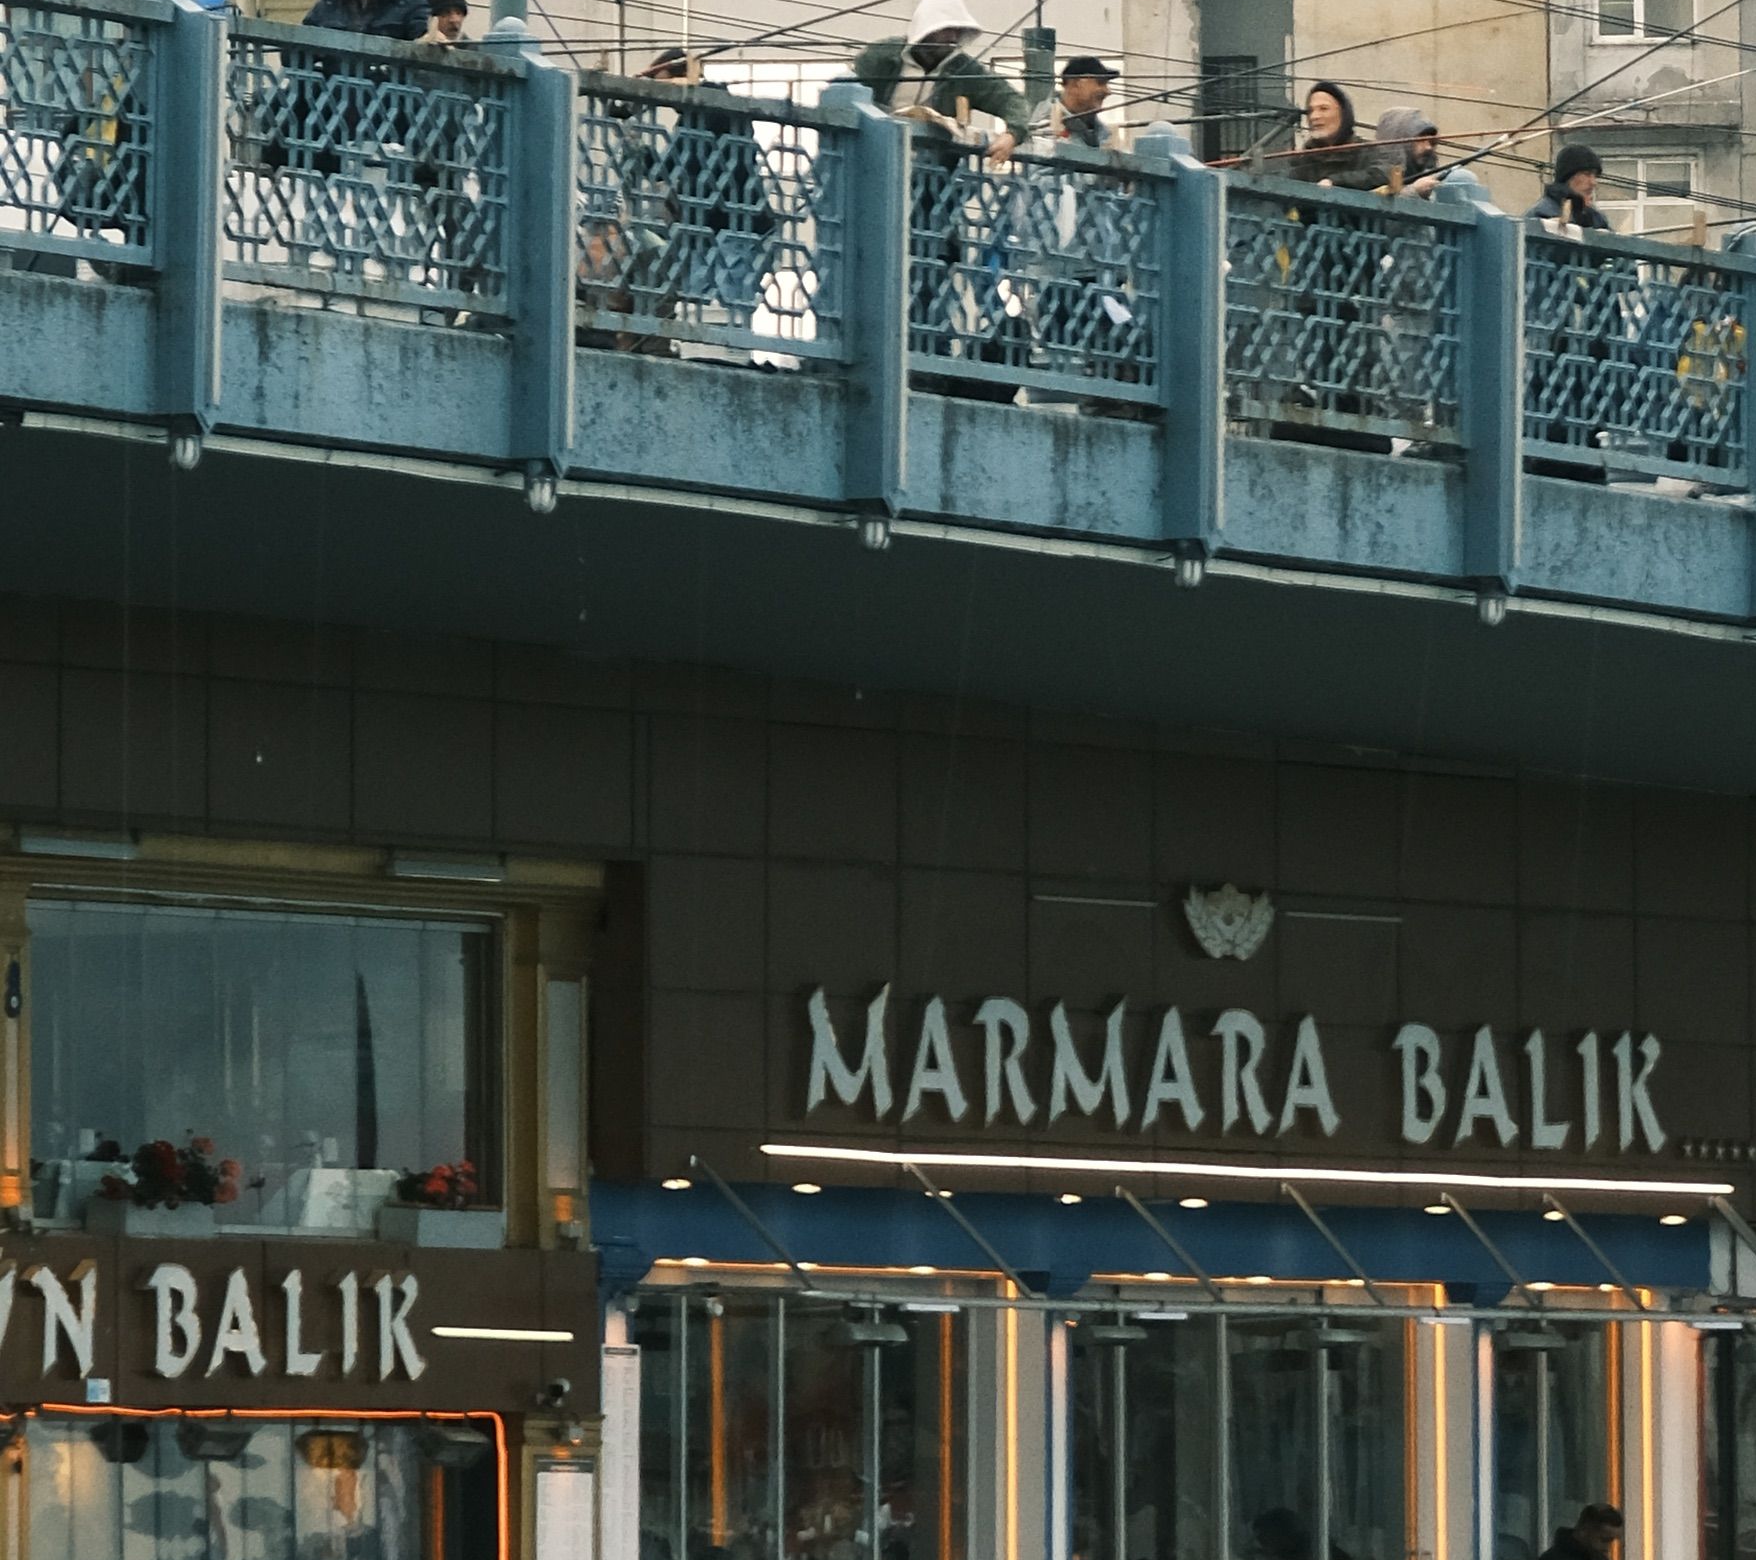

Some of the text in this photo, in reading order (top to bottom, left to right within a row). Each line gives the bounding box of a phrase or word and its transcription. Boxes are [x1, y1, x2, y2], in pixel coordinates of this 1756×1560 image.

[806, 982, 1667, 1153] MARMARA BALIK
[148, 1262, 427, 1381] BALIK
